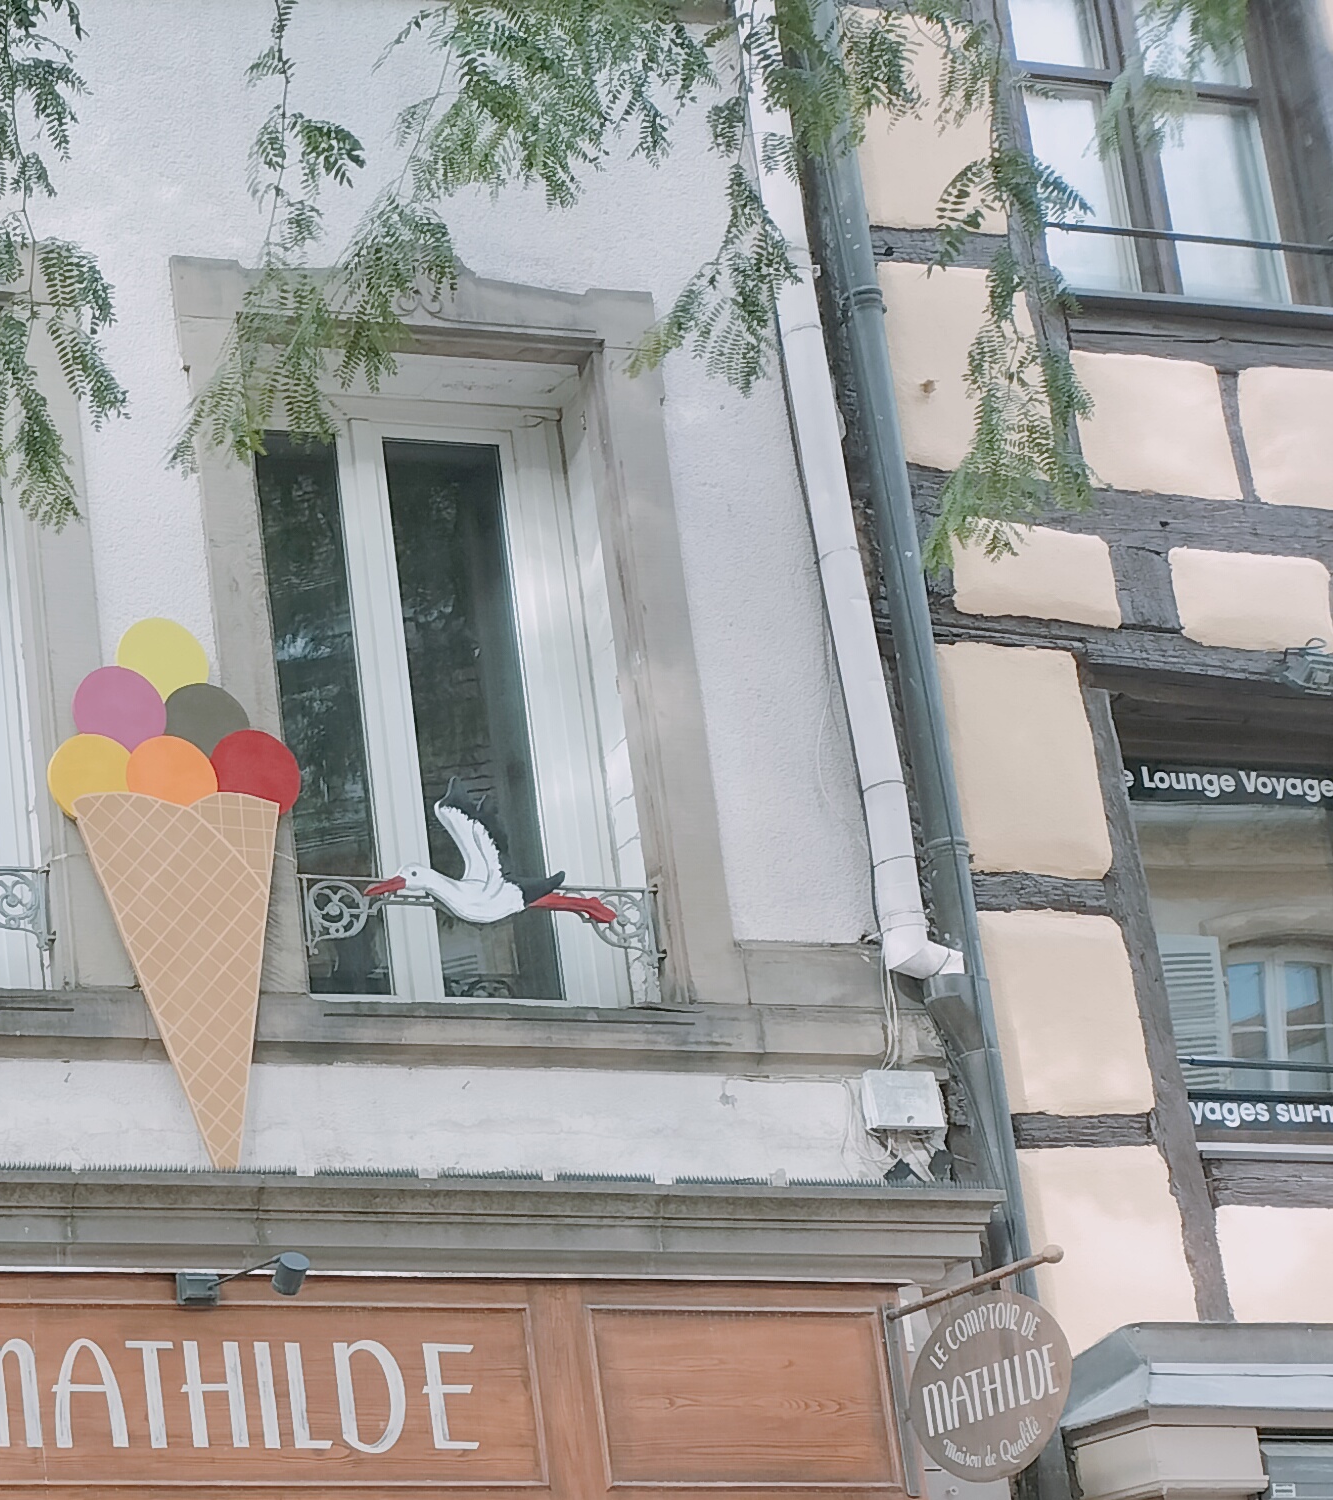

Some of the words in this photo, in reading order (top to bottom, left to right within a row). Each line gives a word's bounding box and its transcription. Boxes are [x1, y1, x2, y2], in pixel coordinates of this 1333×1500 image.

[1140, 766, 1236, 798] Lounge
[1188, 1101, 1270, 1128] yages
[929, 1342, 949, 1370] LE
[945, 1302, 1021, 1350] COMPTOIR
[1021, 1311, 1041, 1341] DE
[922, 1343, 1060, 1438] MATHILDE
[943, 1438, 981, 1467] Maison
[985, 1445, 997, 1467] de
[999, 1416, 1042, 1464] Qualité
